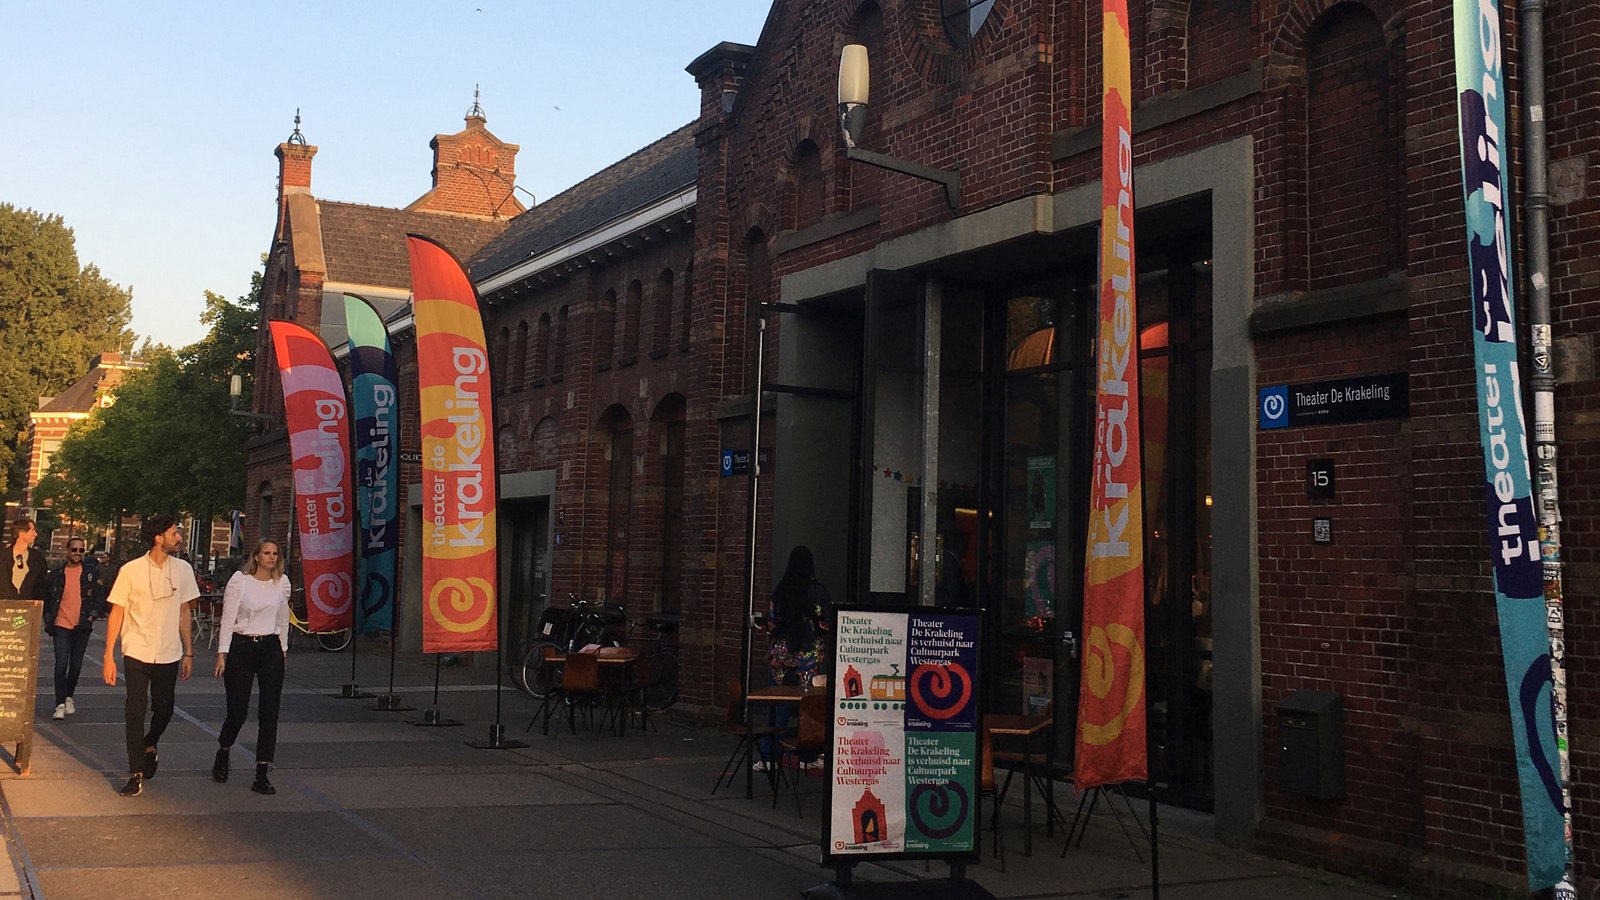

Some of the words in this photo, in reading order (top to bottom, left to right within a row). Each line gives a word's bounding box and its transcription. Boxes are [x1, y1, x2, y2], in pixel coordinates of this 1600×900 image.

[1091, 126, 1131, 557] krakeling
[1296, 392, 1328, 406] Theater
[1331, 389, 1342, 403] De
[1345, 384, 1390, 401] Krakeling
[445, 347, 487, 547] krakeling
[431, 445, 445, 469] de
[368, 384, 395, 549] krakeling
[312, 399, 346, 550] krakeling
[1312, 471, 1329, 486] 15
[301, 476, 314, 492] de
[431, 475, 446, 547] theater
[304, 498, 320, 552] theater
[841, 616, 872, 625] Theater
[912, 619, 944, 628] Theater
[841, 626, 850, 635] De
[853, 627, 892, 637] Krakeling
[912, 629, 922, 637] De
[925, 629, 963, 639] Krakeling
[849, 636, 882, 645] verhuisd
[920, 639, 954, 648] verhuisd
[840, 646, 888, 656] Cultuurpark
[911, 648, 960, 658] Cultuurpark
[840, 655, 880, 664] Westergas
[911, 657, 951, 666] Westergas
[838, 737, 869, 746] Theater
[908, 737, 938, 746] Theater
[838, 747, 848, 755] De
[851, 747, 889, 757] Krakeling
[908, 747, 918, 755] De
[920, 747, 960, 757] Krakeling
[846, 757, 881, 766] verhuisd
[917, 757, 952, 766] verhuisd
[837, 766, 887, 776] Cultuurpark
[908, 766, 957, 776] Cultuurpark
[837, 777, 879, 787] Westergas
[908, 776, 949, 786] Westergas
